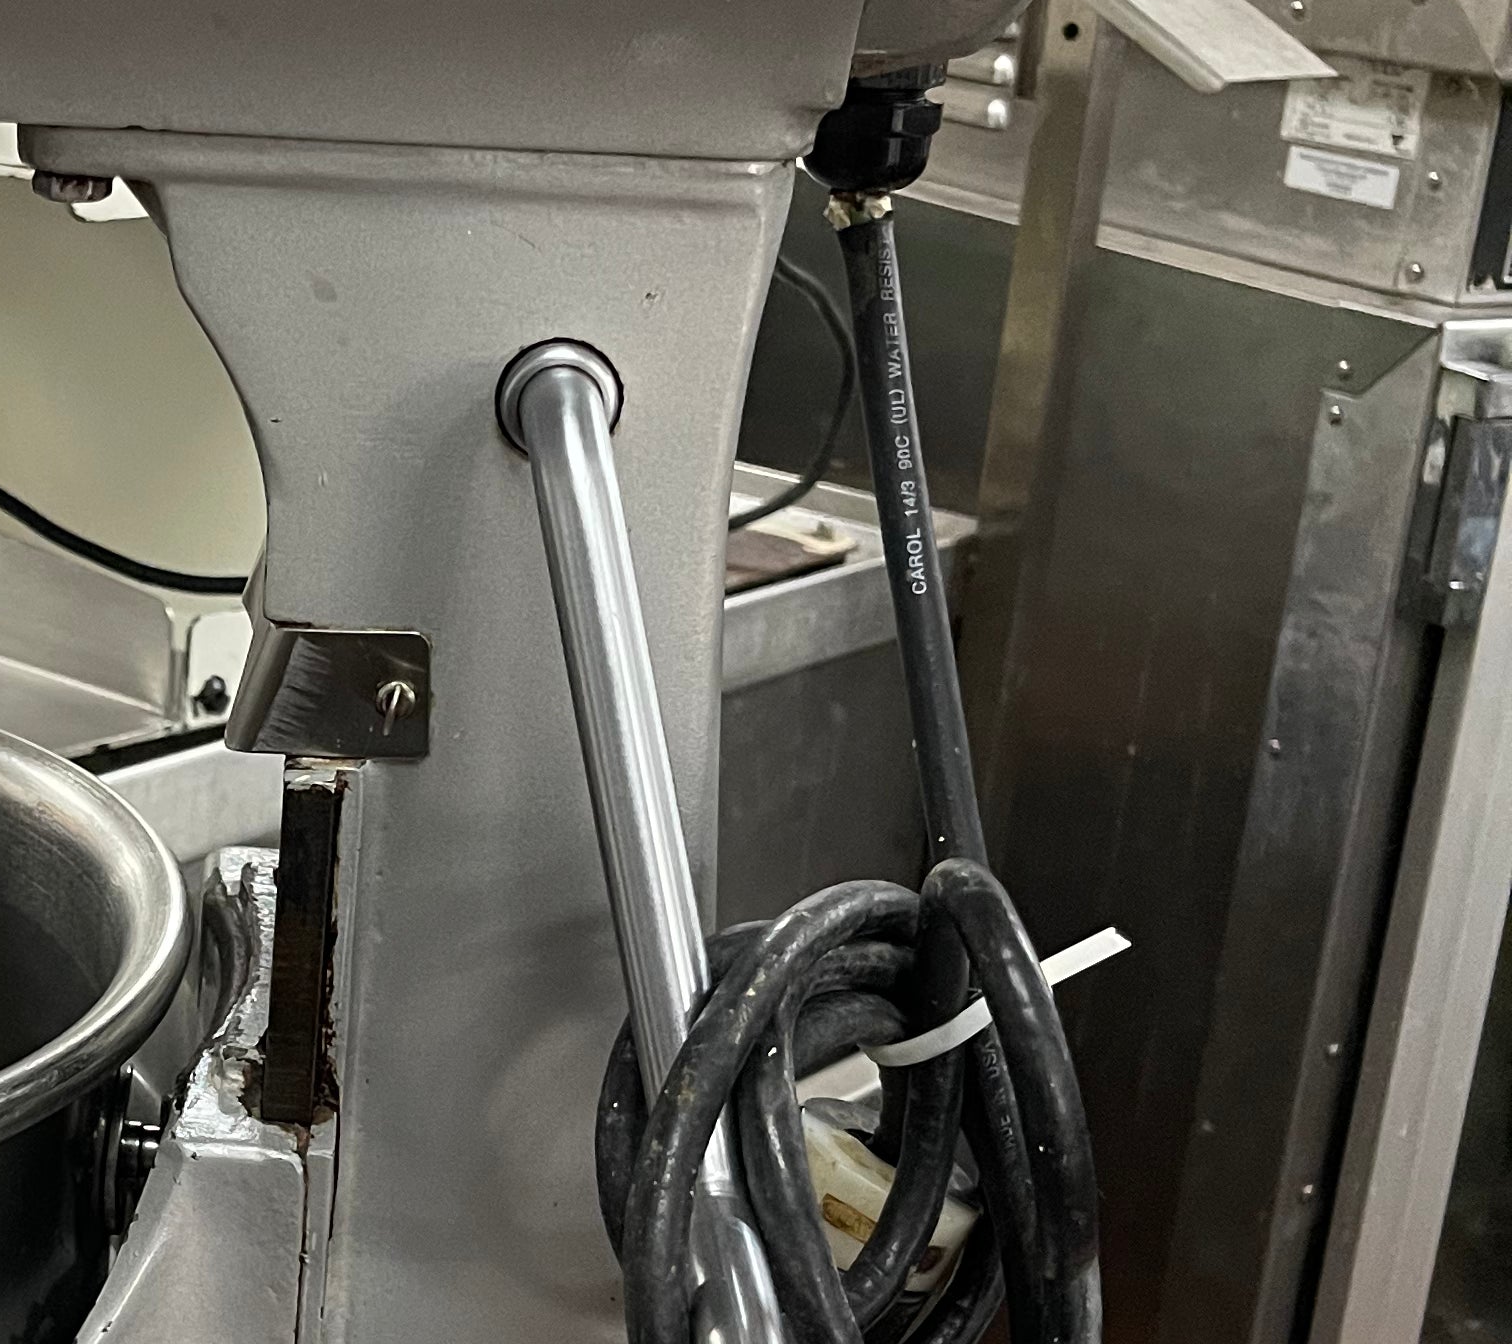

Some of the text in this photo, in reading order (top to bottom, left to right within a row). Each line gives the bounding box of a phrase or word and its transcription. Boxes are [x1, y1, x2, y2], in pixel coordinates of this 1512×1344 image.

[883, 312, 903, 379] WATER
[888, 389, 908, 424] (UL)
[894, 435, 912, 470] 90C
[900, 480, 919, 517] 14/3
[906, 527, 927, 595] CAROL
